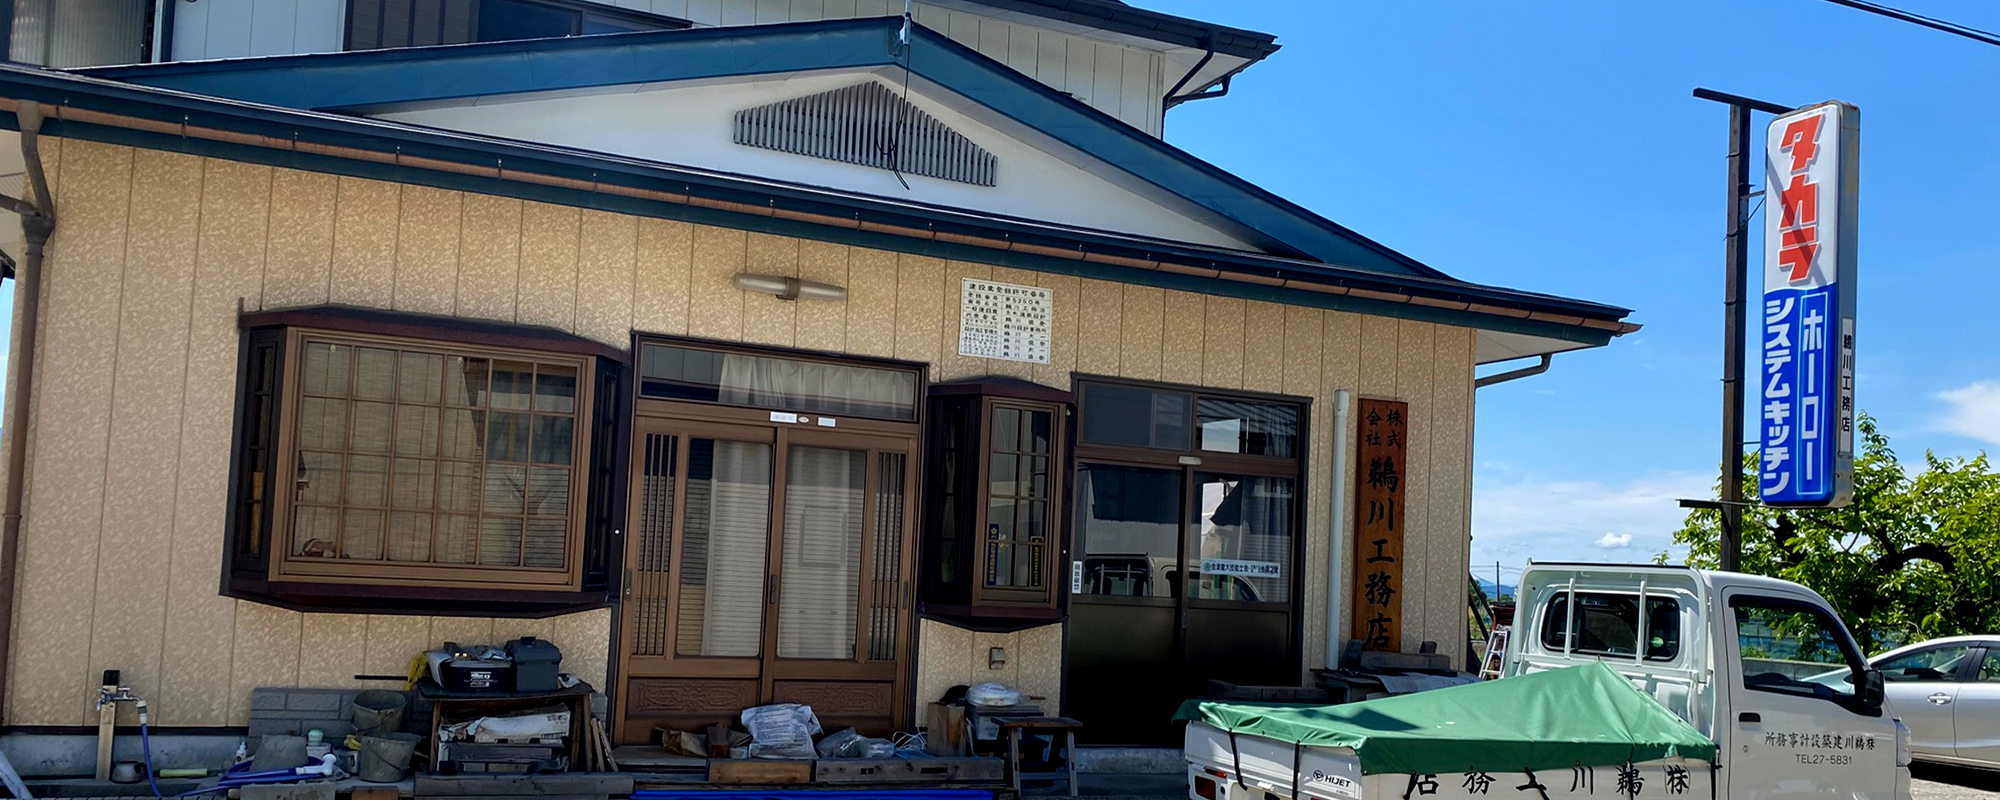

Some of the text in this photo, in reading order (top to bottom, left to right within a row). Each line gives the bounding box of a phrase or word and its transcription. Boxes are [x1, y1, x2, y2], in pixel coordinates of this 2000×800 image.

[1779, 113, 1824, 282] タカラ
[1763, 297, 1794, 496] システムキッチン
[1802, 313, 1823, 481] ホーロー
[1842, 334, 1853, 432] 鵜川工務店
[1364, 457, 1399, 650] 鵜川工務店
[1325, 775, 1351, 788] HIJET
[1796, 754, 1853, 765] TEL27-5831
